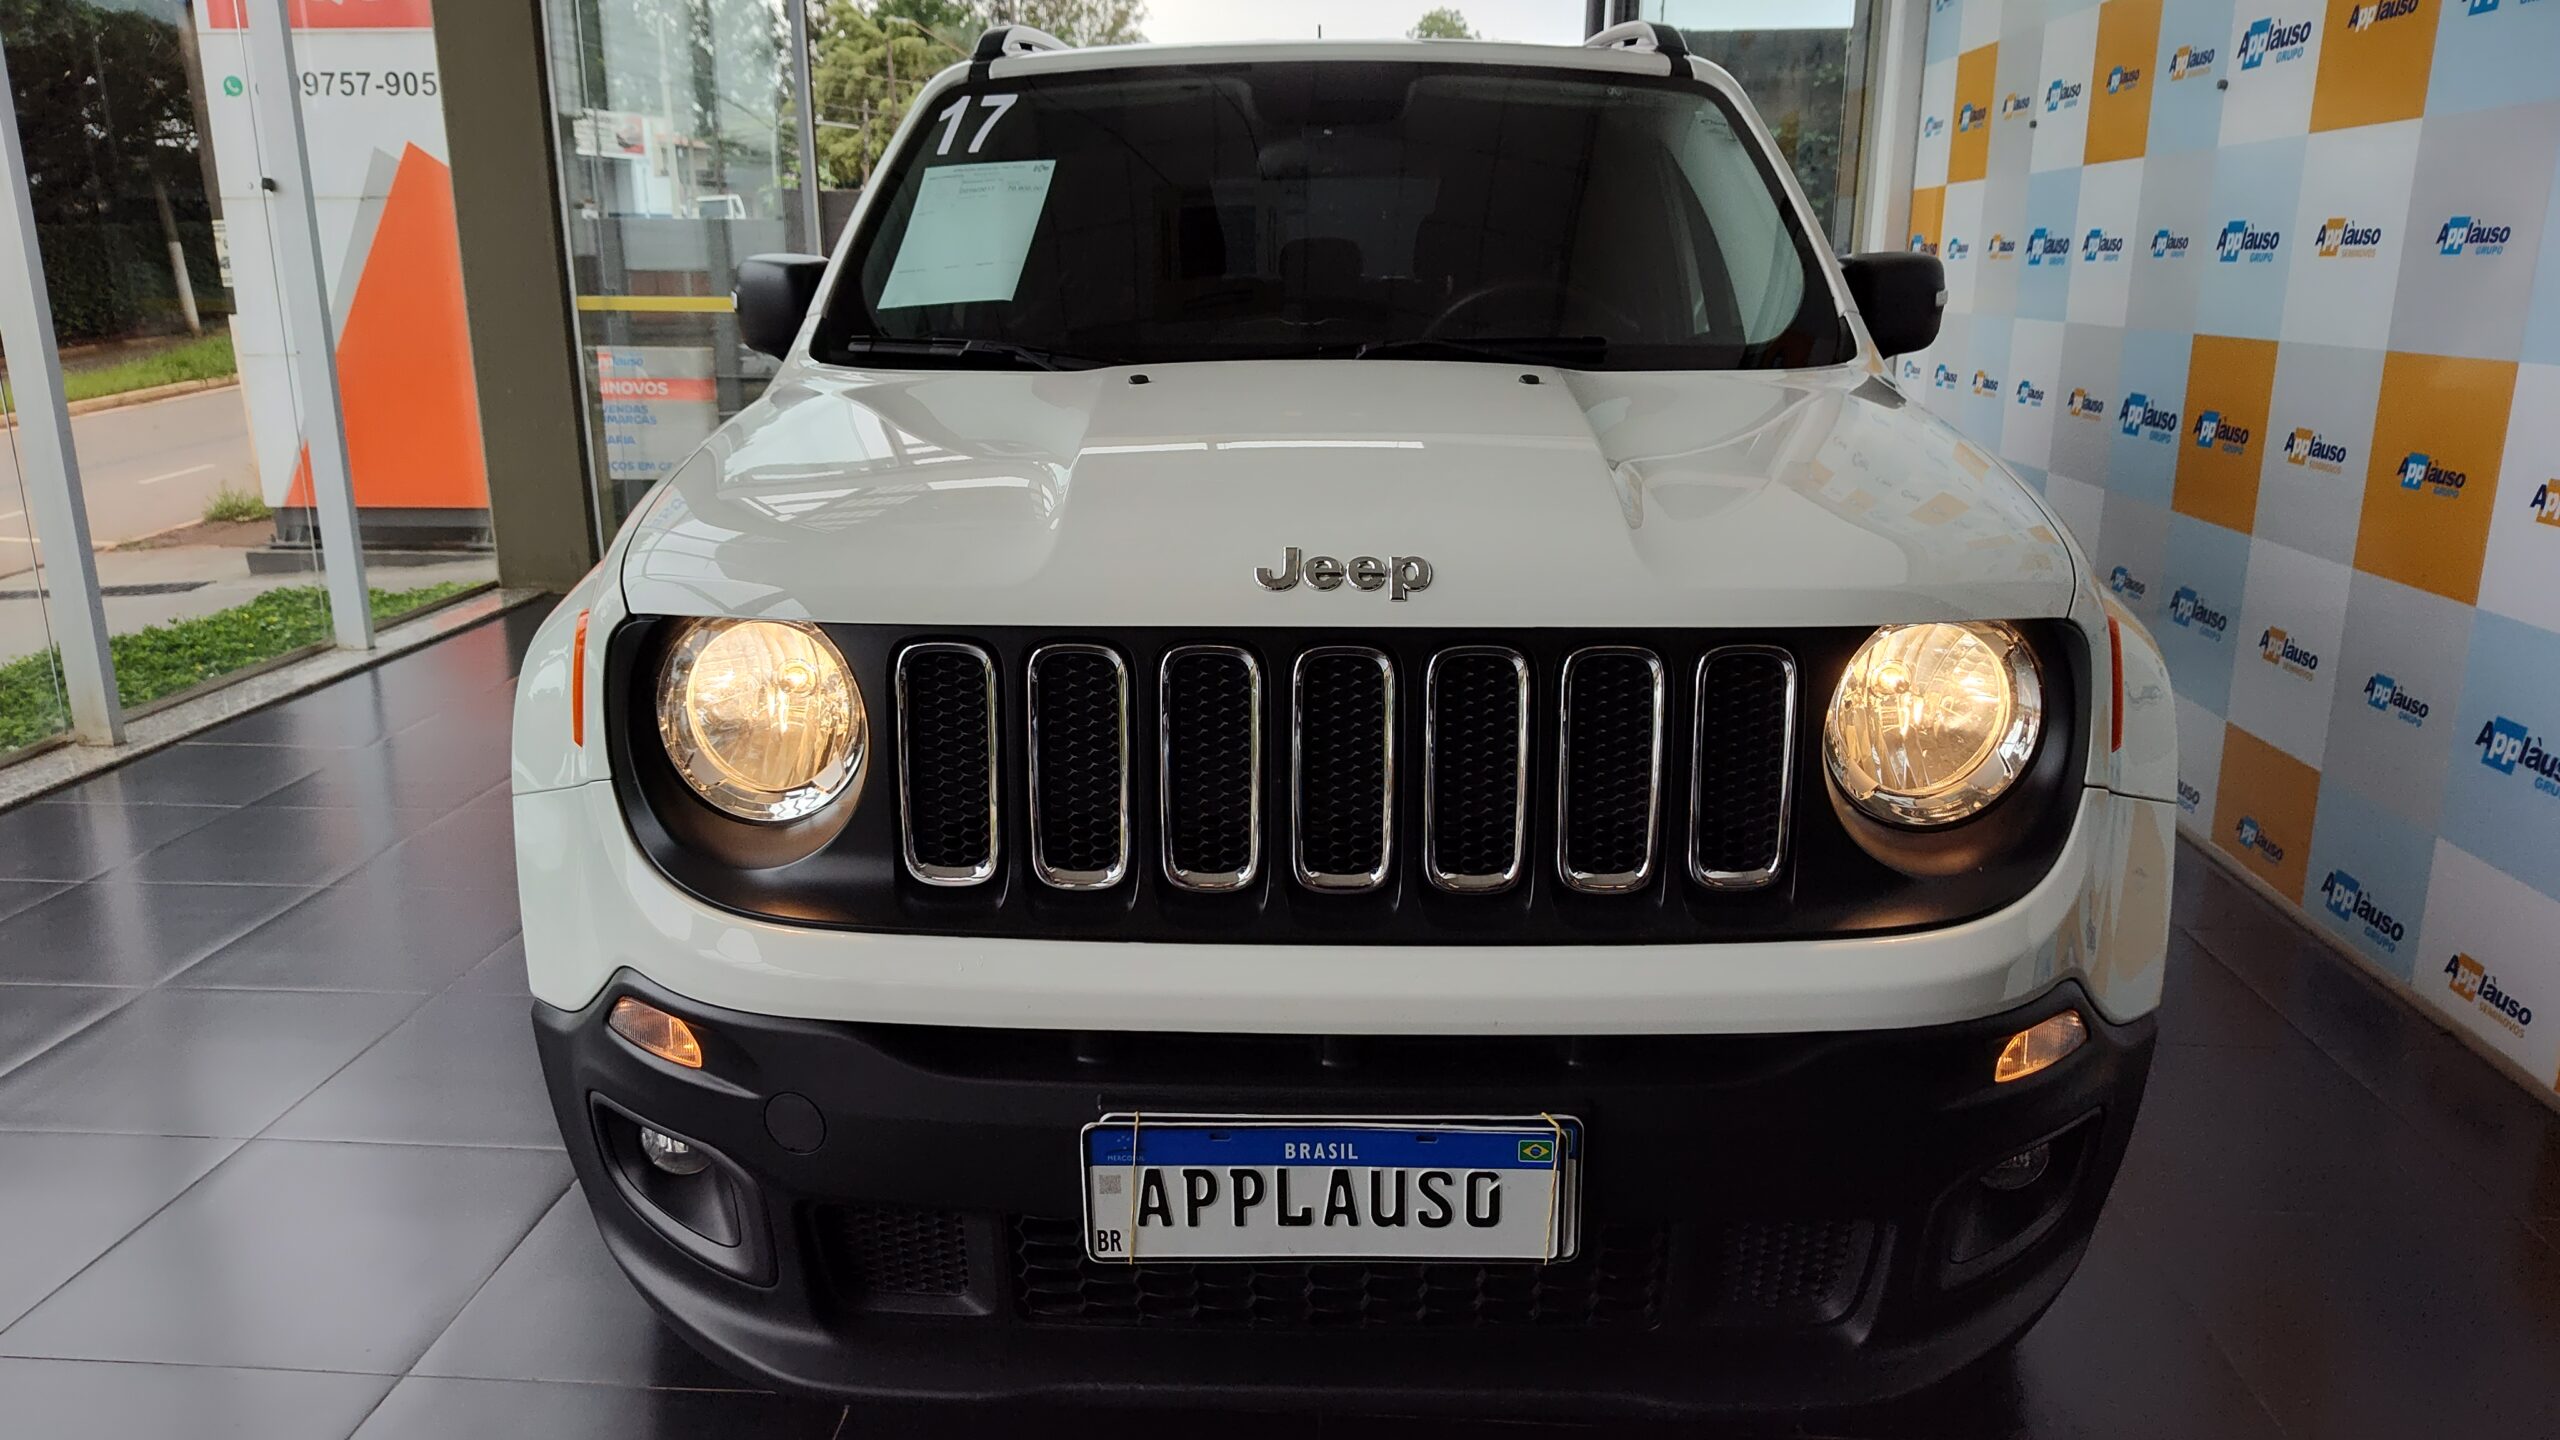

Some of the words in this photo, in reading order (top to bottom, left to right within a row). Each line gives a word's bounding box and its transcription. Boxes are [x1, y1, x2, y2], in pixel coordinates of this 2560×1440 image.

[2276, 47, 2304, 63] GRUPO
[299, 72, 437, 96] 9757-905
[937, 94, 1019, 155] 17
[1254, 547, 1433, 602] Jeep
[1107, 1154, 1146, 1162] MERCOUL
[1285, 1142, 1359, 1160] BRASIL
[1097, 1230, 1122, 1252] BR
